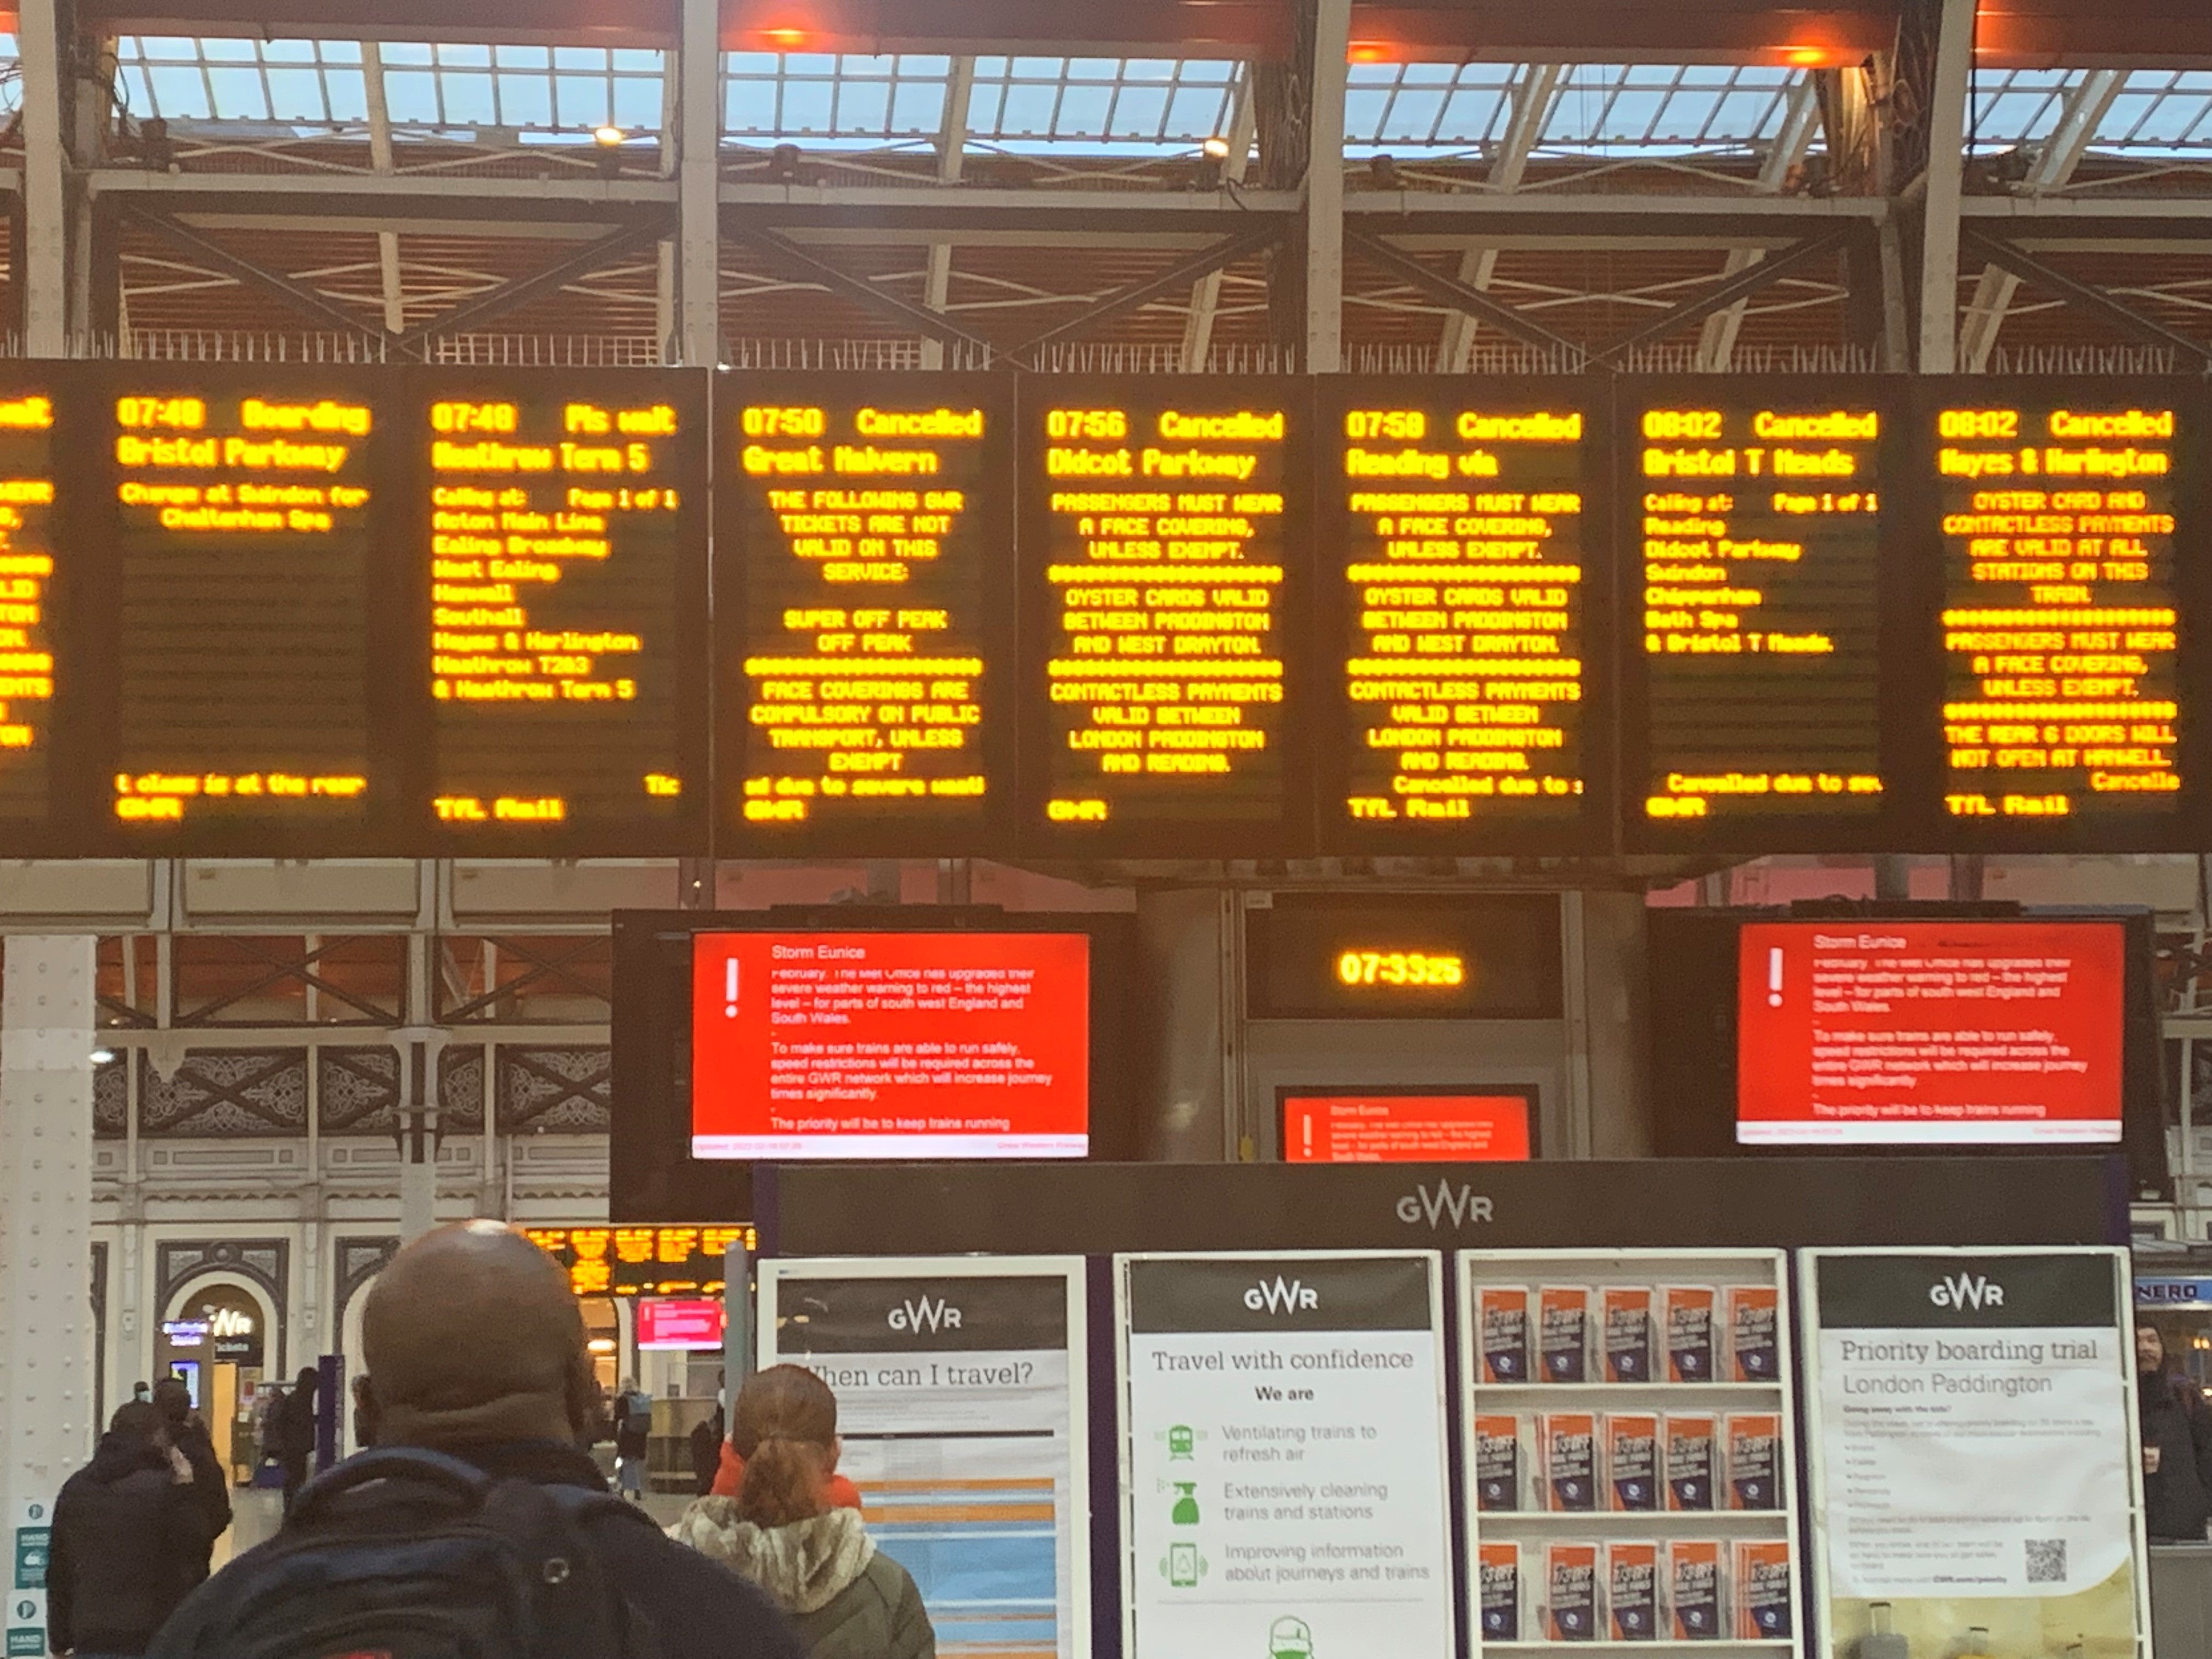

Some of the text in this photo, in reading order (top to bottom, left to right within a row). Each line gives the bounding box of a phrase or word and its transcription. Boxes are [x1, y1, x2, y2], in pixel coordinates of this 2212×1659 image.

[242, 400, 370, 434] Boarding
[566, 404, 675, 433] Pls wait
[856, 409, 982, 436] Cancelled
[1159, 411, 1283, 438] Cancelled
[1457, 413, 1581, 439] Cancelled
[1755, 412, 1877, 437] Cancelled
[2051, 411, 2172, 436] Cancelled
[118, 436, 346, 471] Bristol Parkway
[432, 442, 648, 471] Heathrow Term 5
[743, 445, 938, 473] Great Malvern
[1644, 449, 1854, 475] Bristol T Heads
[1940, 448, 2166, 477] Hayes & Harlington
[1047, 448, 1256, 479] Didcot Parkway
[1347, 449, 1498, 479] Reading via
[769, 491, 963, 510] THE FOLLOWING GWR
[780, 515, 950, 533] TICKETS ARE NOT
[1645, 517, 1725, 536] Reading
[794, 538, 937, 557] VALID ON THIS
[1089, 541, 1161, 559] UNLESS
[1645, 540, 1800, 560] Didcot Parkway
[433, 607, 524, 626] Southall
[784, 610, 947, 628] SUPER OFF PEAK
[817, 634, 912, 652] OFF PEAK
[762, 681, 968, 699] FACE COVERINGS ARE
[751, 705, 979, 724] COMPULSORY ON PUBLIC
[769, 729, 963, 747] TRANSPORT, UNLESS
[829, 752, 903, 771] EXEMPT
[1407, 799, 1470, 817] Rail
[2005, 796, 2068, 814] Rail
[773, 945, 865, 958] Storm Eunice
[1815, 935, 1906, 949] Storm Eunice
[771, 1012, 806, 1024] South
[772, 1042, 787, 1053] To
[827, 1044, 854, 1054] sure
[856, 1043, 890, 1053] trains
[944, 1043, 956, 1053] to
[960, 1045, 979, 1053] run
[772, 1118, 1009, 1131] The priority will be to keep trains running
[1397, 1178, 1493, 1229] GWR
[1244, 1274, 1318, 1315] GWR
[1929, 1271, 2004, 1311] GWR
[2137, 1284, 2198, 1299] NERO
[888, 1295, 962, 1334] GWR
[1152, 1349, 1414, 1371] Travel with confidence
[1840, 1339, 2098, 1365] Priority boarding trial
[877, 1368, 922, 1387] can
[930, 1364, 941, 1386] I
[947, 1362, 1034, 1385] travel?
[1254, 1385, 1314, 1401] We are
[1843, 1373, 2052, 1398] London Paddington
[1221, 1425, 1377, 1443] Ventilating trains to
[1223, 1447, 1304, 1462] refresh air
[1224, 1482, 1388, 1500] Extensively cleaning
[1223, 1505, 1374, 1521] trains and stations
[1225, 1543, 1404, 1562] Improving information
[1225, 1565, 1430, 1584] about journeys and trains
